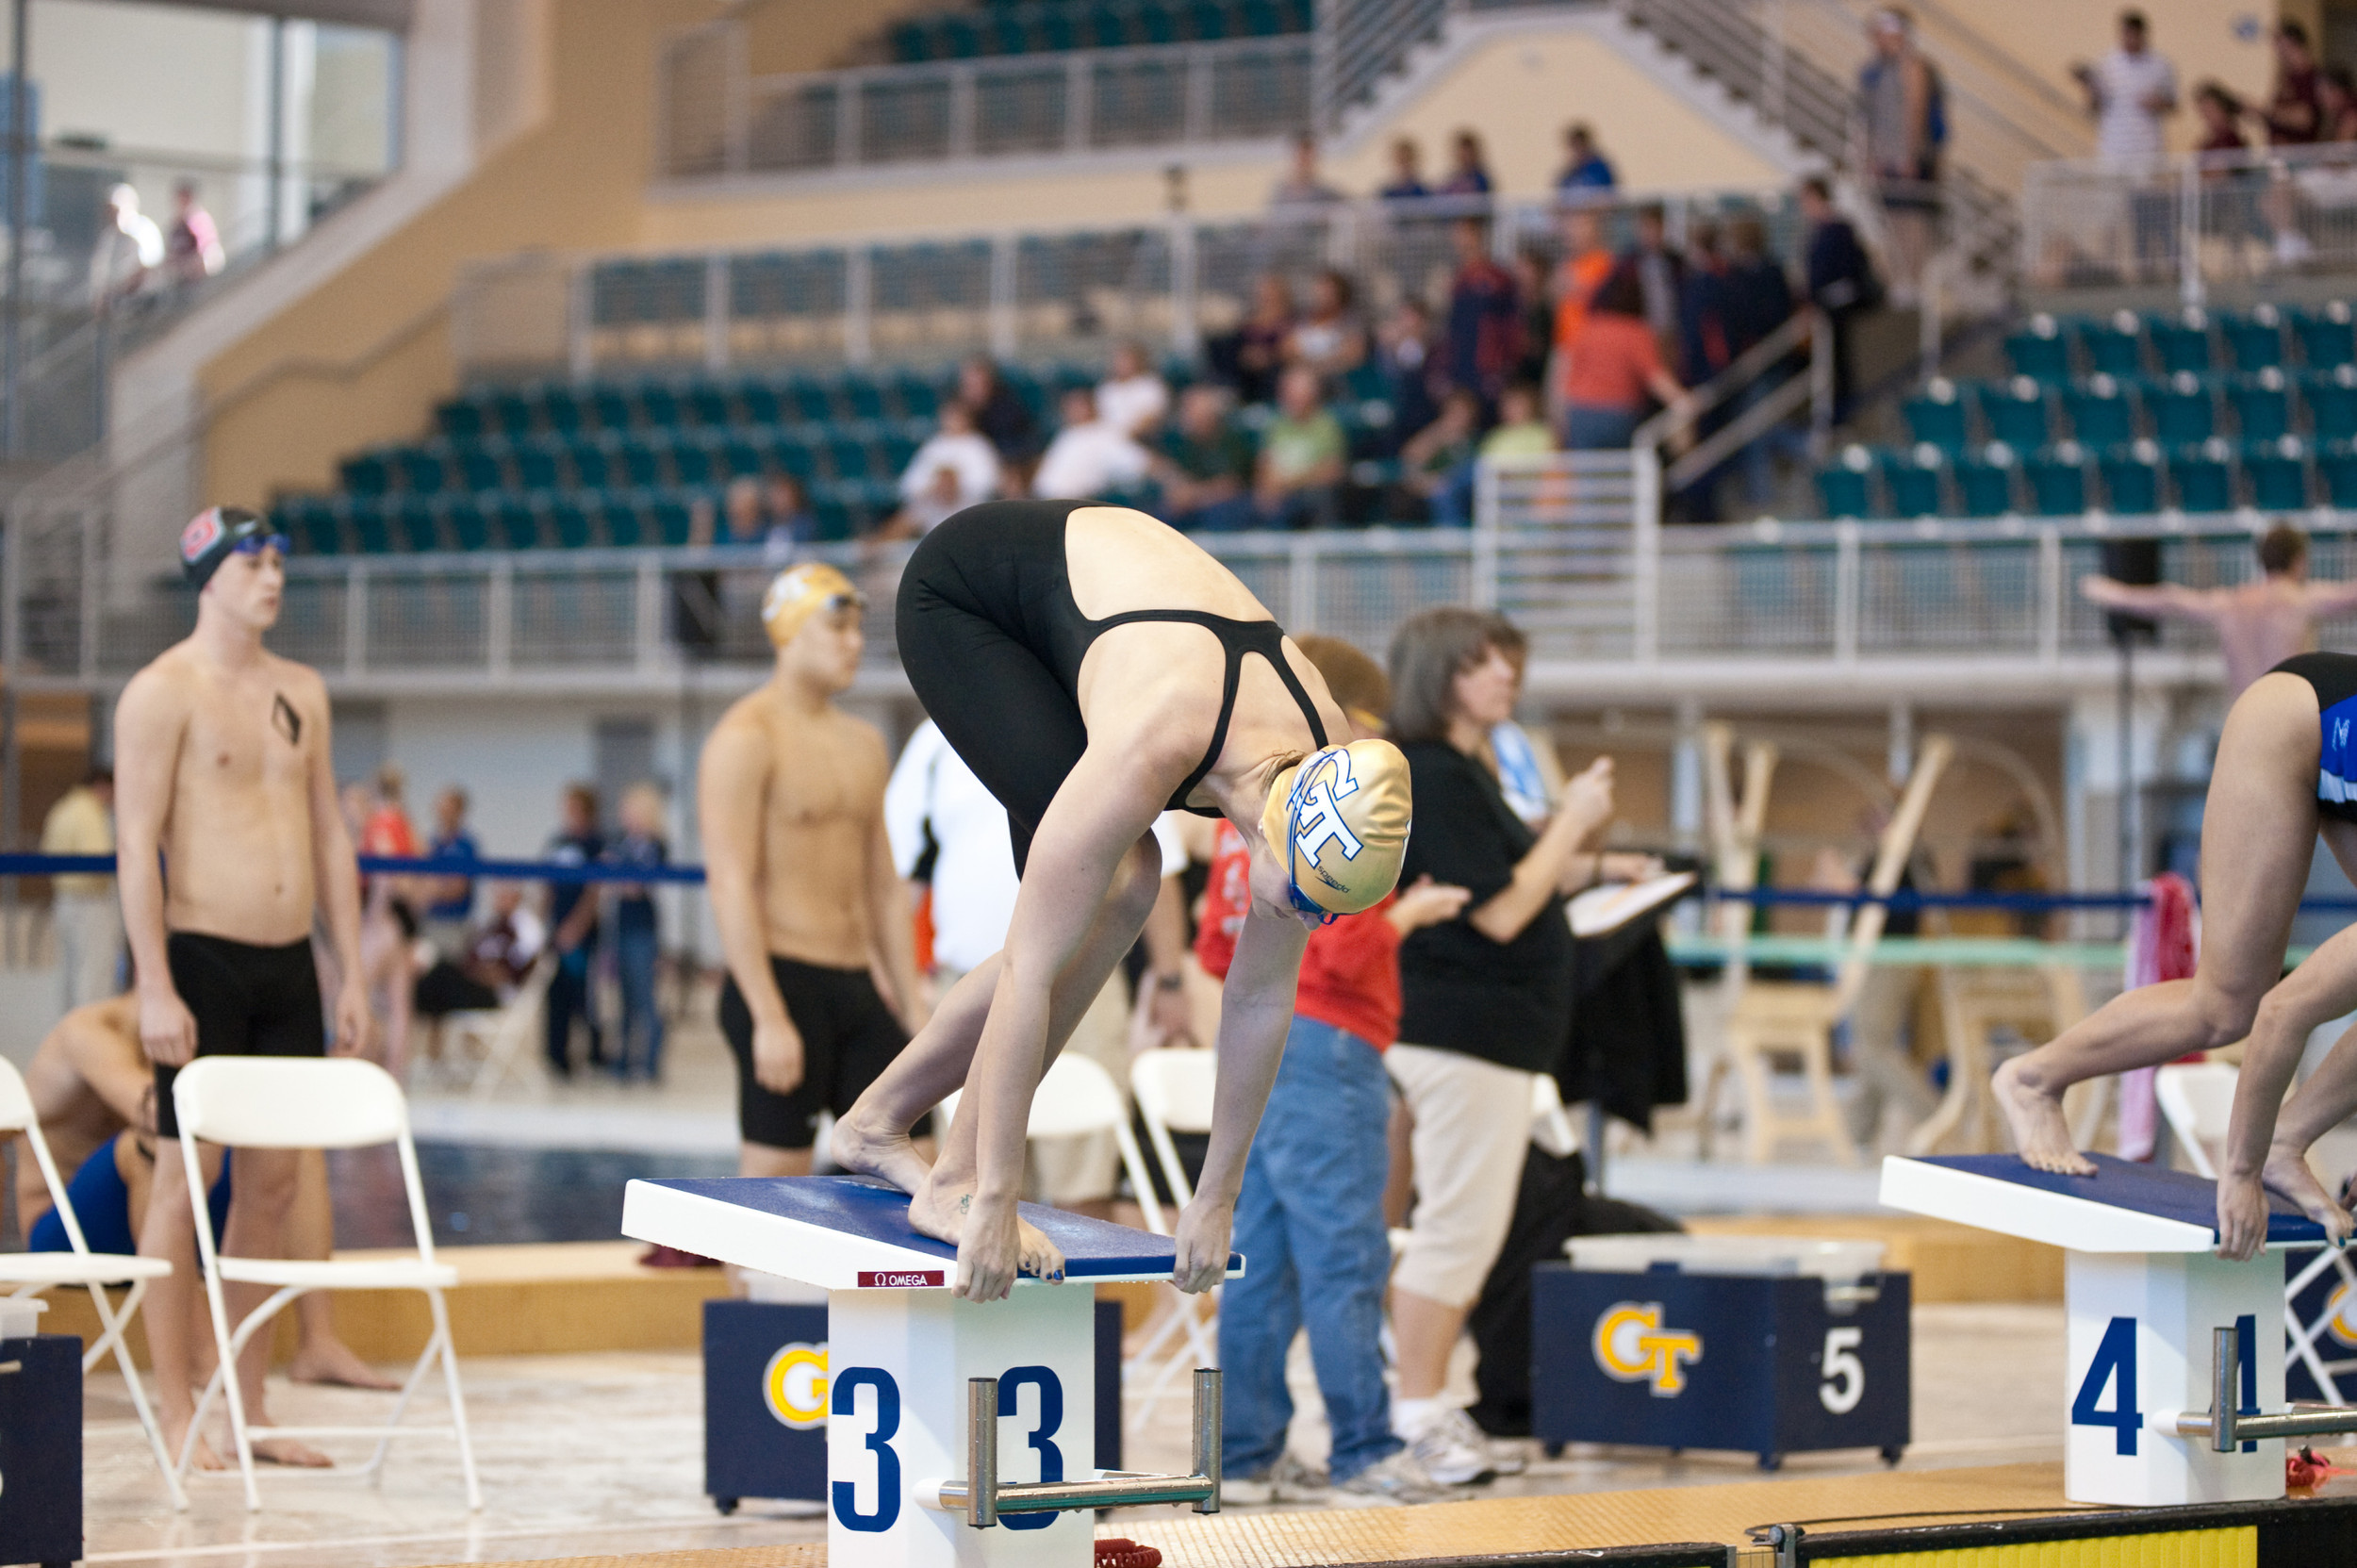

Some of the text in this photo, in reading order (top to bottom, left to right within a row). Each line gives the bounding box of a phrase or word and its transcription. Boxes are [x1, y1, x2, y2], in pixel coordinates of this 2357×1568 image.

[888, 1274, 928, 1286] OMEGA
[762, 1341, 829, 1432] G
[1591, 1300, 1704, 1398] GT
[1819, 1326, 1874, 1414] 5
[2071, 1315, 2143, 1456] 4
[832, 1366, 900, 1533] 3
[997, 1364, 1063, 1531] 3
